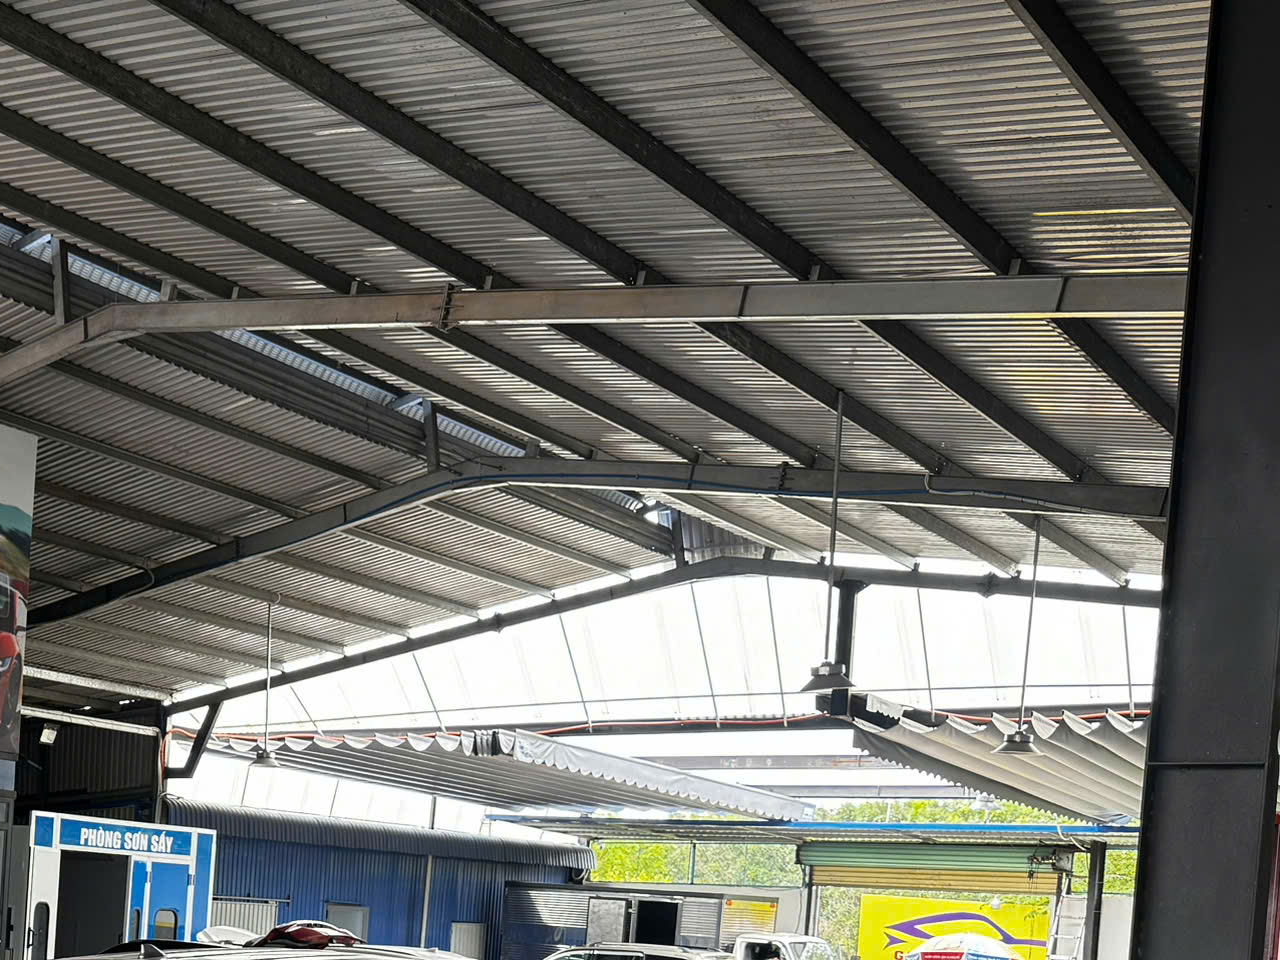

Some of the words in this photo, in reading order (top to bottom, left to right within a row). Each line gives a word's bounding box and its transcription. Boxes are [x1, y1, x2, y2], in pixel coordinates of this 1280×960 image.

[80, 826, 121, 849] PHÒNG
[124, 831, 148, 851] SƠN
[151, 830, 174, 853] SẤY
